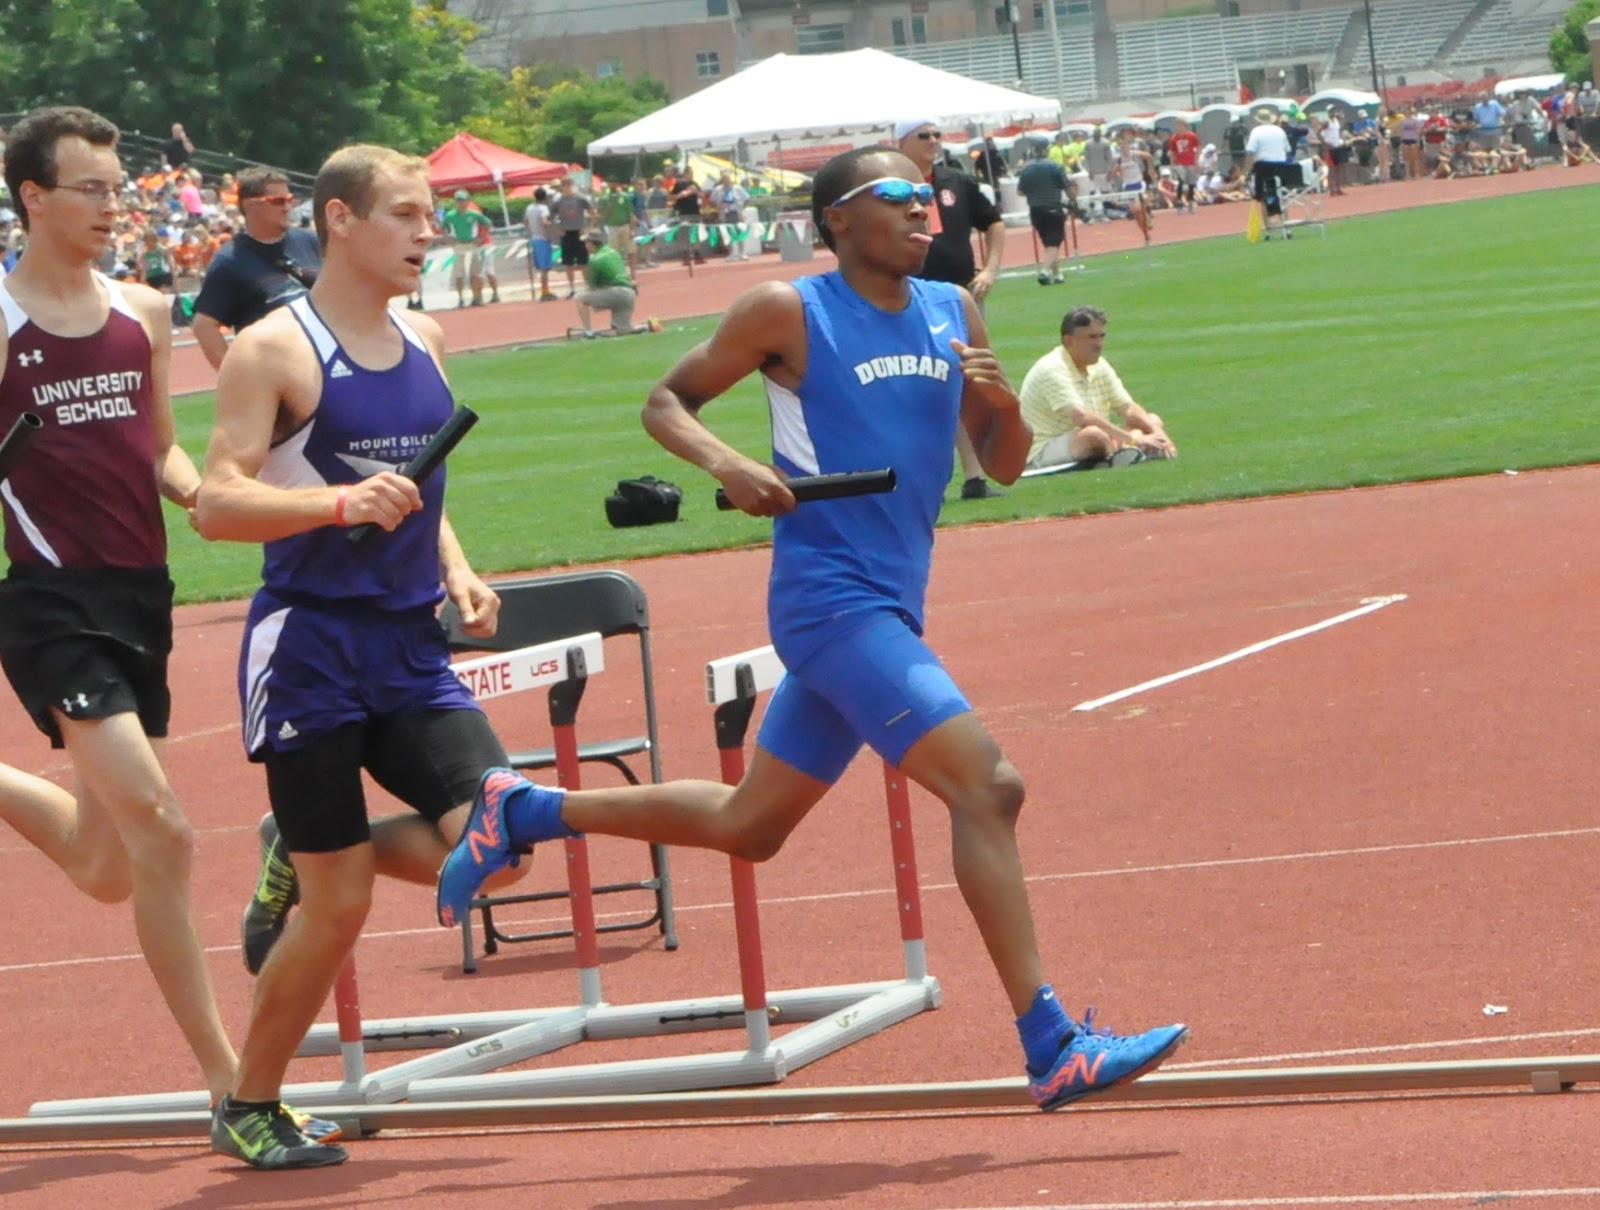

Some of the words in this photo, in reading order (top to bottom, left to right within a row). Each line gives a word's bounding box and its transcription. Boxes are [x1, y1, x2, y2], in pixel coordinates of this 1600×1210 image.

[853, 354, 950, 386] DUNBAR
[31, 370, 143, 406] UNIVERSITY
[55, 396, 138, 426] SCHOOL
[349, 436, 397, 451] MOUNT
[530, 659, 559, 677] UCS
